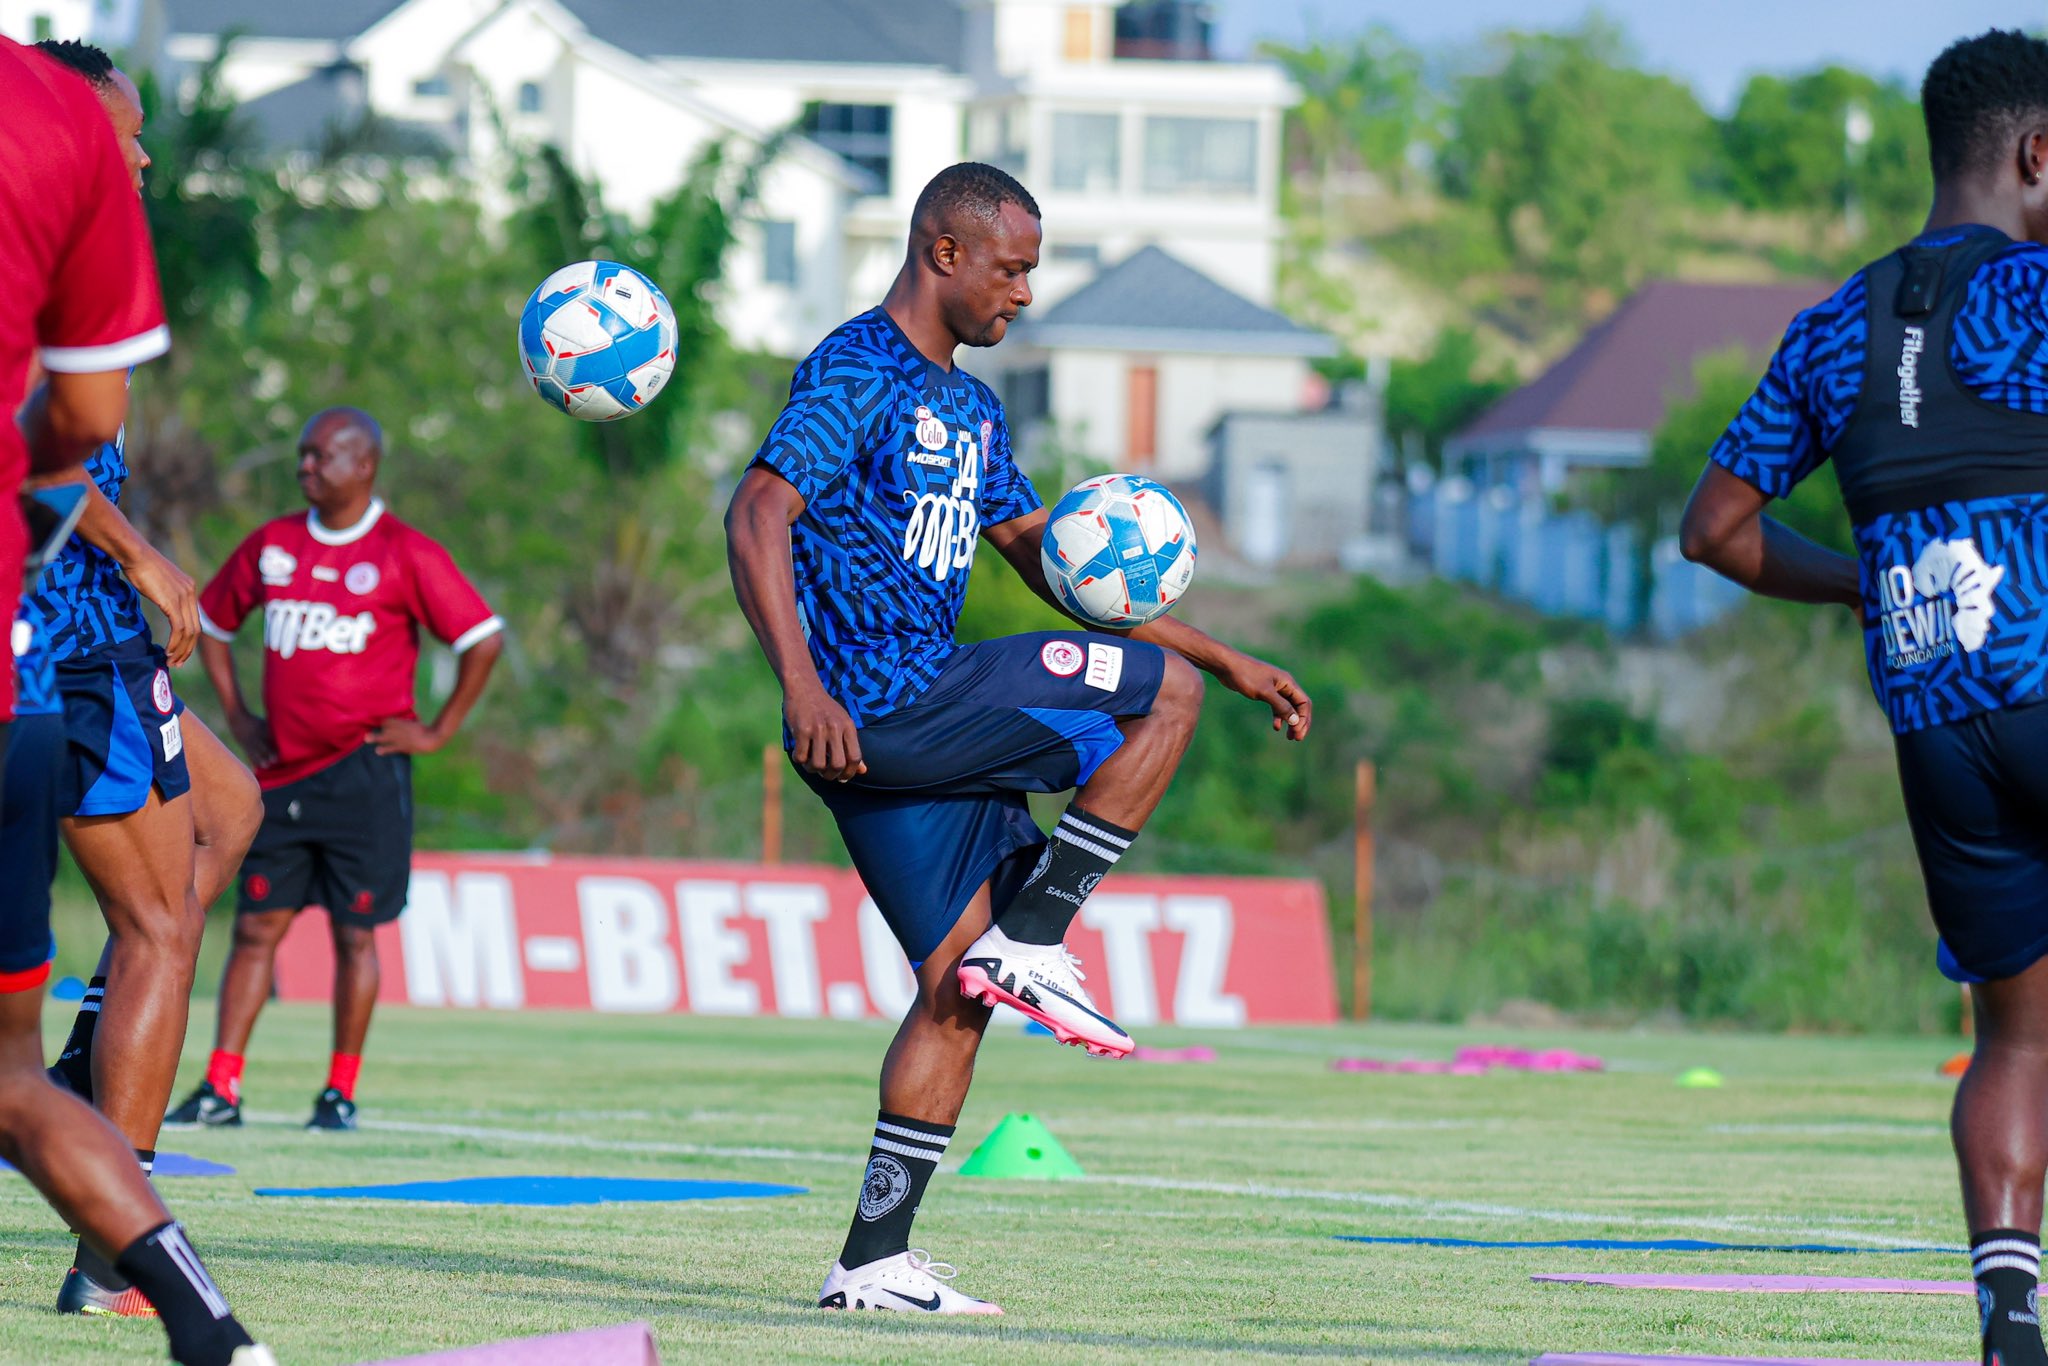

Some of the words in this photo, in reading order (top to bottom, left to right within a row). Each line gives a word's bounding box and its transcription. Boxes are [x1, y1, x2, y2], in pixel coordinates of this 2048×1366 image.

[1897, 326, 1924, 429] Fitogether
[921, 422, 943, 444] Cola
[953, 441, 977, 500] 34
[1881, 598, 1953, 657] DEWJI
[1028, 970, 1044, 982] EM
[1046, 979, 1059, 990] 10
[871, 1160, 901, 1179] SIMBA
